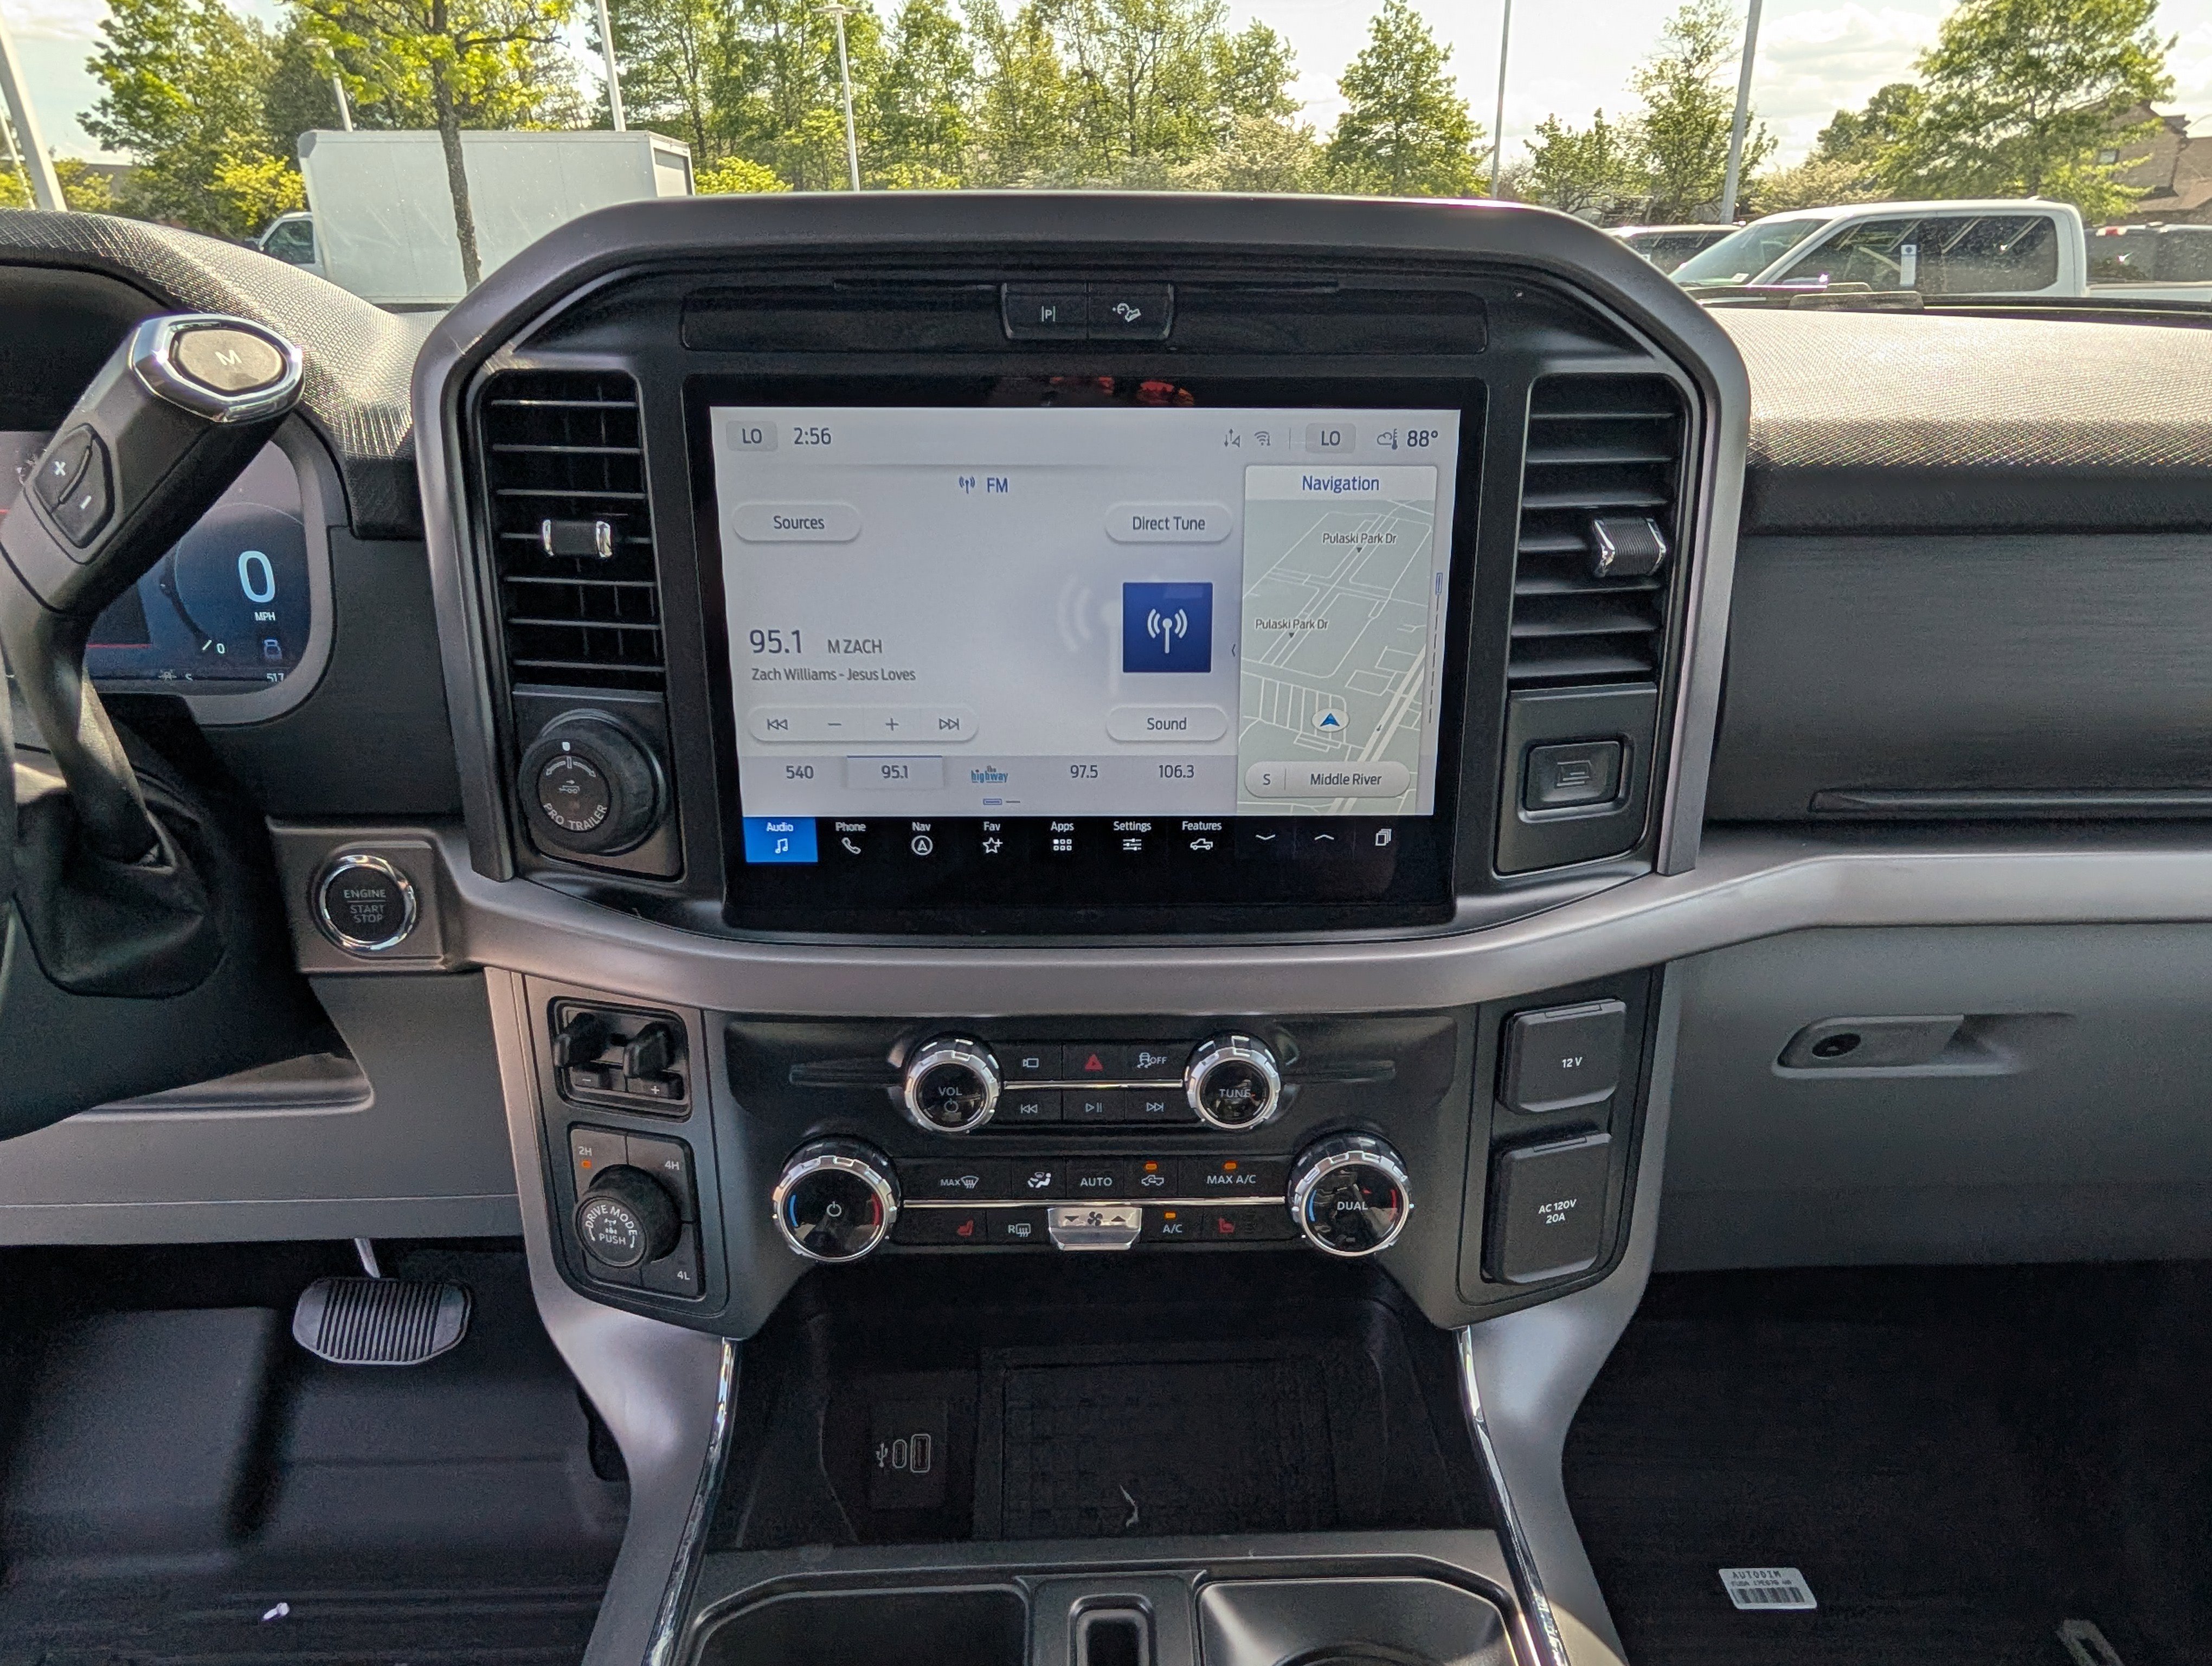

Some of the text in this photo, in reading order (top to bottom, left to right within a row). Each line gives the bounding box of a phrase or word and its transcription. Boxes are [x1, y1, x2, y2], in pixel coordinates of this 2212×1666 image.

[215, 349, 242, 366] M
[742, 428, 762, 444] LO
[793, 427, 832, 445] 2:56
[1321, 430, 1340, 446] LO
[1406, 430, 1439, 447] 88°
[986, 477, 1008, 493] FM
[1302, 475, 1380, 494] Navigation
[773, 515, 825, 530] Sources
[1132, 516, 1206, 530] Direct Tune
[1322, 533, 1397, 544] Pulaski Park Dr
[238, 550, 276, 603] 0
[254, 612, 276, 622] MPH
[1255, 619, 1328, 630] Pulaski Park Dr
[749, 629, 883, 654] 95.1 M ZACH
[751, 668, 782, 681] Zach
[783, 668, 837, 681] Williams
[846, 668, 879, 681] Jesus
[880, 668, 916, 681] Loves
[1146, 716, 1187, 732] Sound
[786, 765, 814, 780] 540
[881, 765, 909, 779] 95.1
[970, 770, 1009, 783] highway
[1070, 765, 1099, 779] 97.5
[1158, 765, 1195, 779] 106.3
[1263, 772, 1382, 786] S Middle River
[543, 803, 608, 831] PRO TRAILER
[766, 822, 794, 832] Audio
[835, 822, 866, 832] Phone
[912, 822, 931, 832] Nav
[983, 821, 1001, 831] Fav
[1050, 821, 1075, 833] Apps
[1113, 821, 1152, 832] Settings
[1181, 820, 1222, 831] Features
[343, 889, 387, 899] ENGINE
[350, 905, 385, 914] START
[353, 914, 383, 924] STOP
[1149, 1056, 1167, 1065] OFF
[1562, 1056, 1583, 1068] 12 V
[937, 1086, 963, 1096] VOL
[1219, 1088, 1252, 1098] TUNE
[578, 1146, 593, 1156] 2H
[664, 1160, 680, 1170] 4H
[940, 1178, 961, 1187] MAX
[1080, 1177, 1113, 1187] AUTO
[1206, 1174, 1257, 1184] MAX A/C
[1336, 1201, 1368, 1211] DUAL
[1539, 1199, 1577, 1214] AC 120V
[585, 1204, 638, 1236] DRIVE MODE
[1546, 1213, 1566, 1224] 20A
[1162, 1224, 1182, 1234] A/C
[599, 1233, 626, 1245] PUSH
[677, 1271, 690, 1280] 4L
